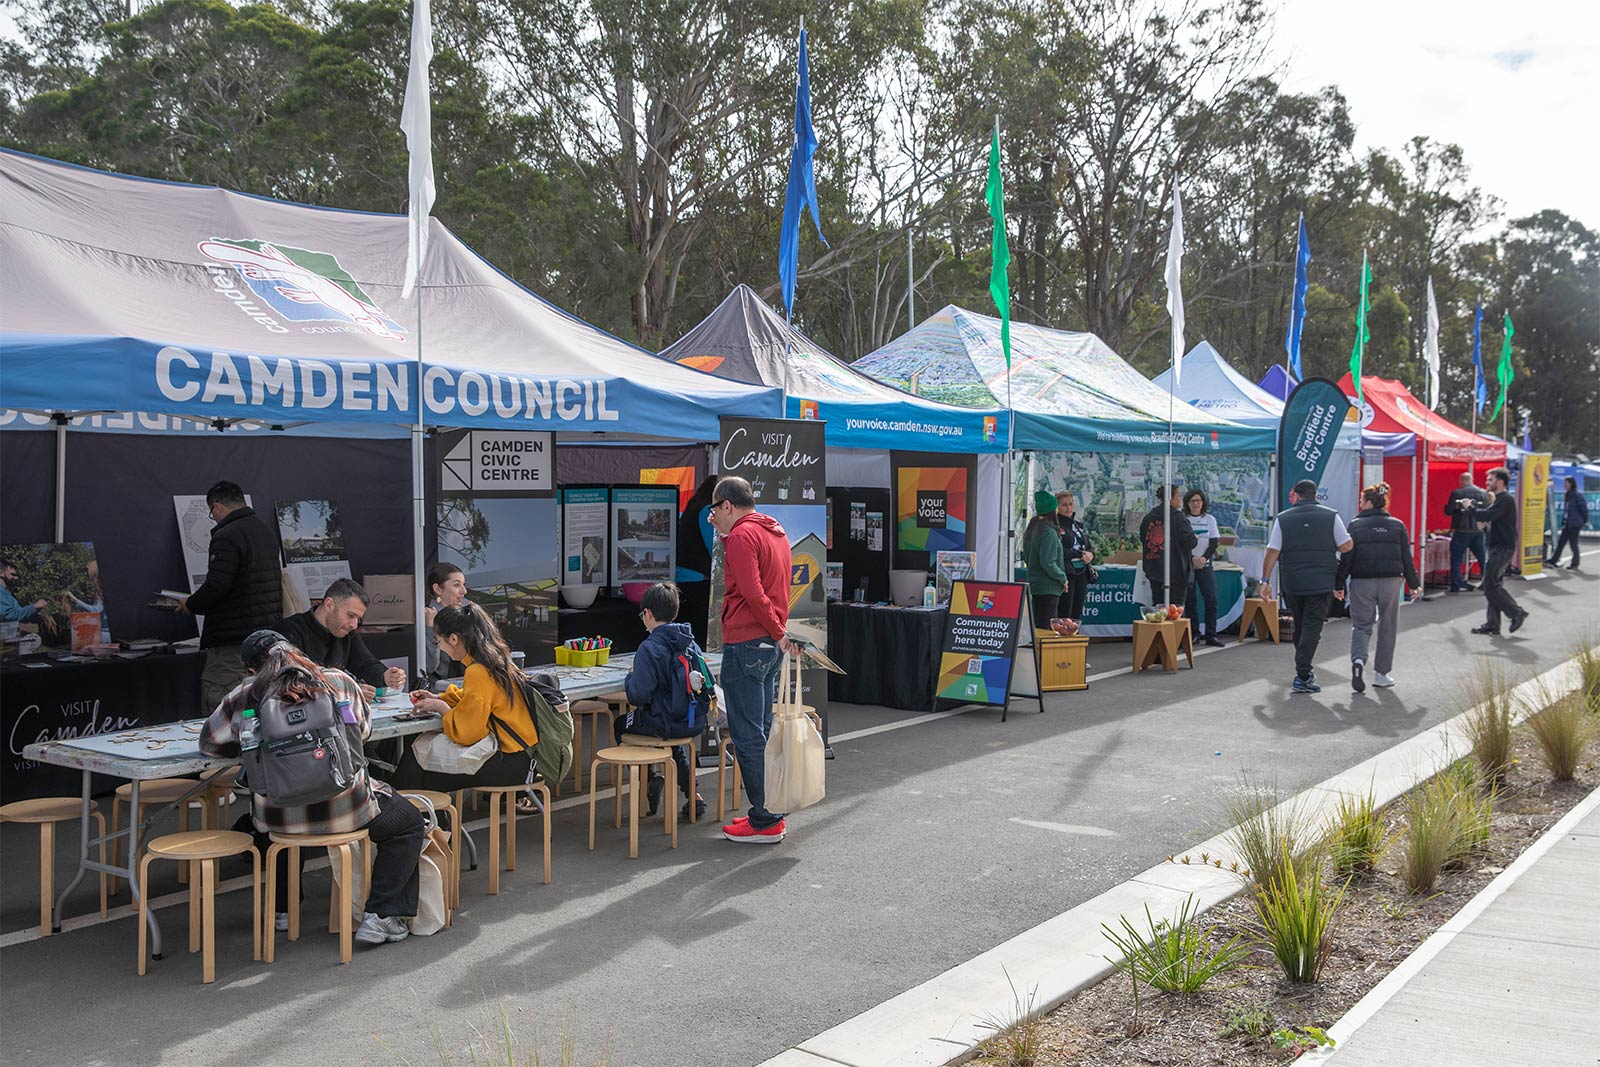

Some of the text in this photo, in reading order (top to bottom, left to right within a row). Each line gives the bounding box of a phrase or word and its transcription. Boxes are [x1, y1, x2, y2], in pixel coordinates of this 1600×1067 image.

[155, 346, 619, 421] CAMDEN COUNCIL
[846, 417, 963, 437] yourvoice.camden.nsw.gov.au
[1296, 404, 1325, 462] Bradfield
[761, 433, 785, 445] VISIT
[1151, 431, 1176, 443] Bradfield
[1176, 432, 1188, 445] City
[1188, 433, 1205, 444] Centre
[1304, 404, 1337, 472] City Centre
[480, 440, 543, 453] CAMDEN
[723, 427, 820, 470] Camden
[480, 454, 521, 466] CIVIC
[480, 468, 539, 481] CENTRE
[920, 498, 944, 509] your
[918, 506, 945, 518] voice
[1086, 591, 1112, 603] field
[1082, 606, 1099, 616] tre
[955, 617, 1010, 631] Community
[952, 627, 1009, 639] consultation
[954, 635, 1004, 649] here today
[60, 699, 92, 717] VISIT
[9, 699, 140, 756] Camden
